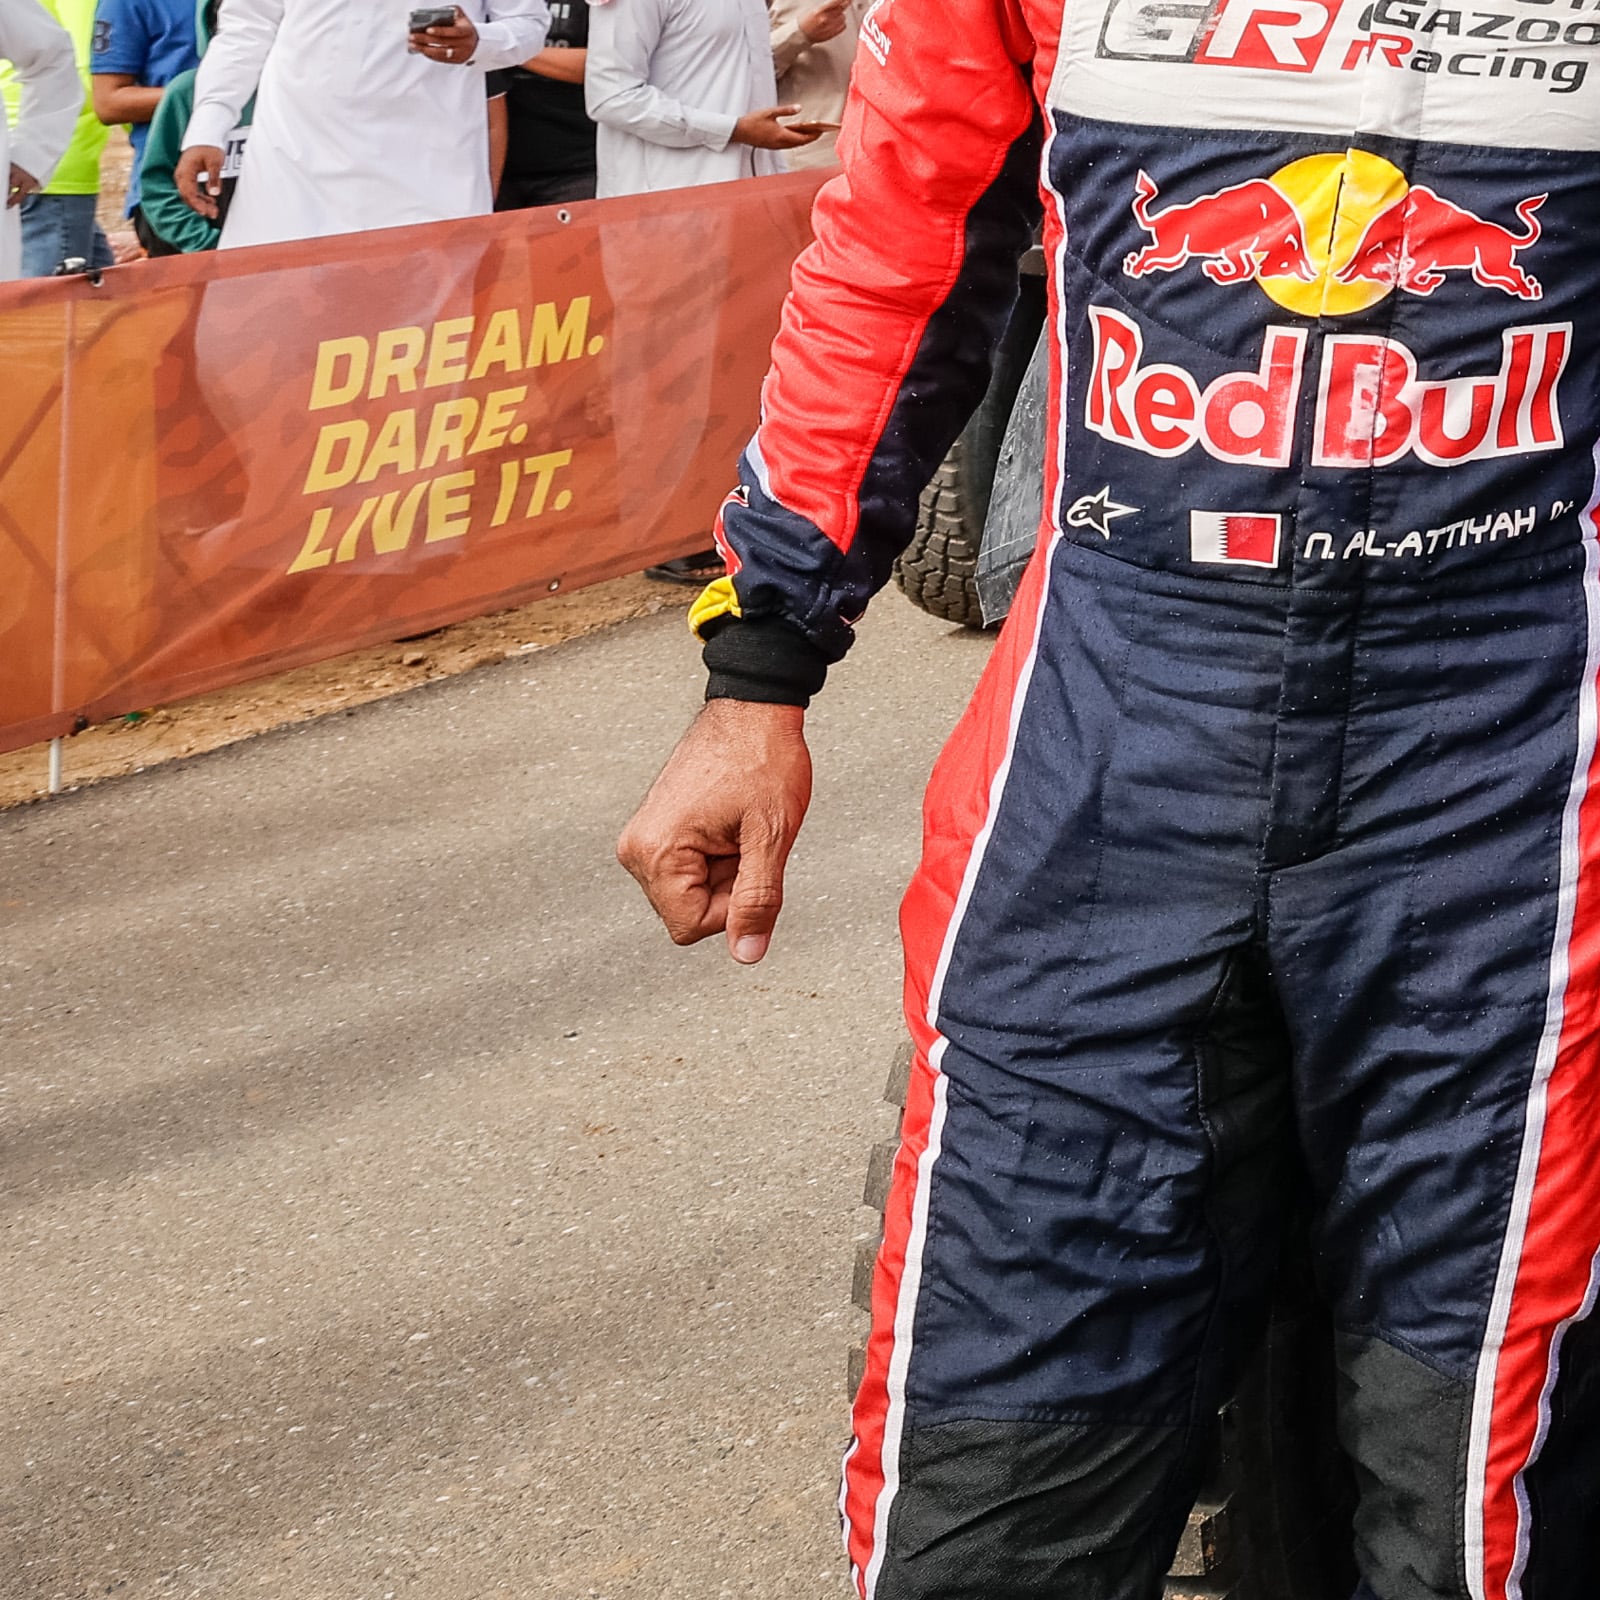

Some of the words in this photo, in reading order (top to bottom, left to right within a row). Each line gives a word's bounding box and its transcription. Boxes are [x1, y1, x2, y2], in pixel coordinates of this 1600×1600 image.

[1342, 31, 1589, 94] Racing
[309, 295, 604, 411] DREAM.
[1085, 305, 1308, 467] Red
[1312, 321, 1573, 467] Bull
[302, 386, 528, 494] DARE.
[287, 470, 474, 576] LIVE
[490, 448, 574, 528] IT.
[1343, 506, 1536, 560] AL-ATTIYAH
